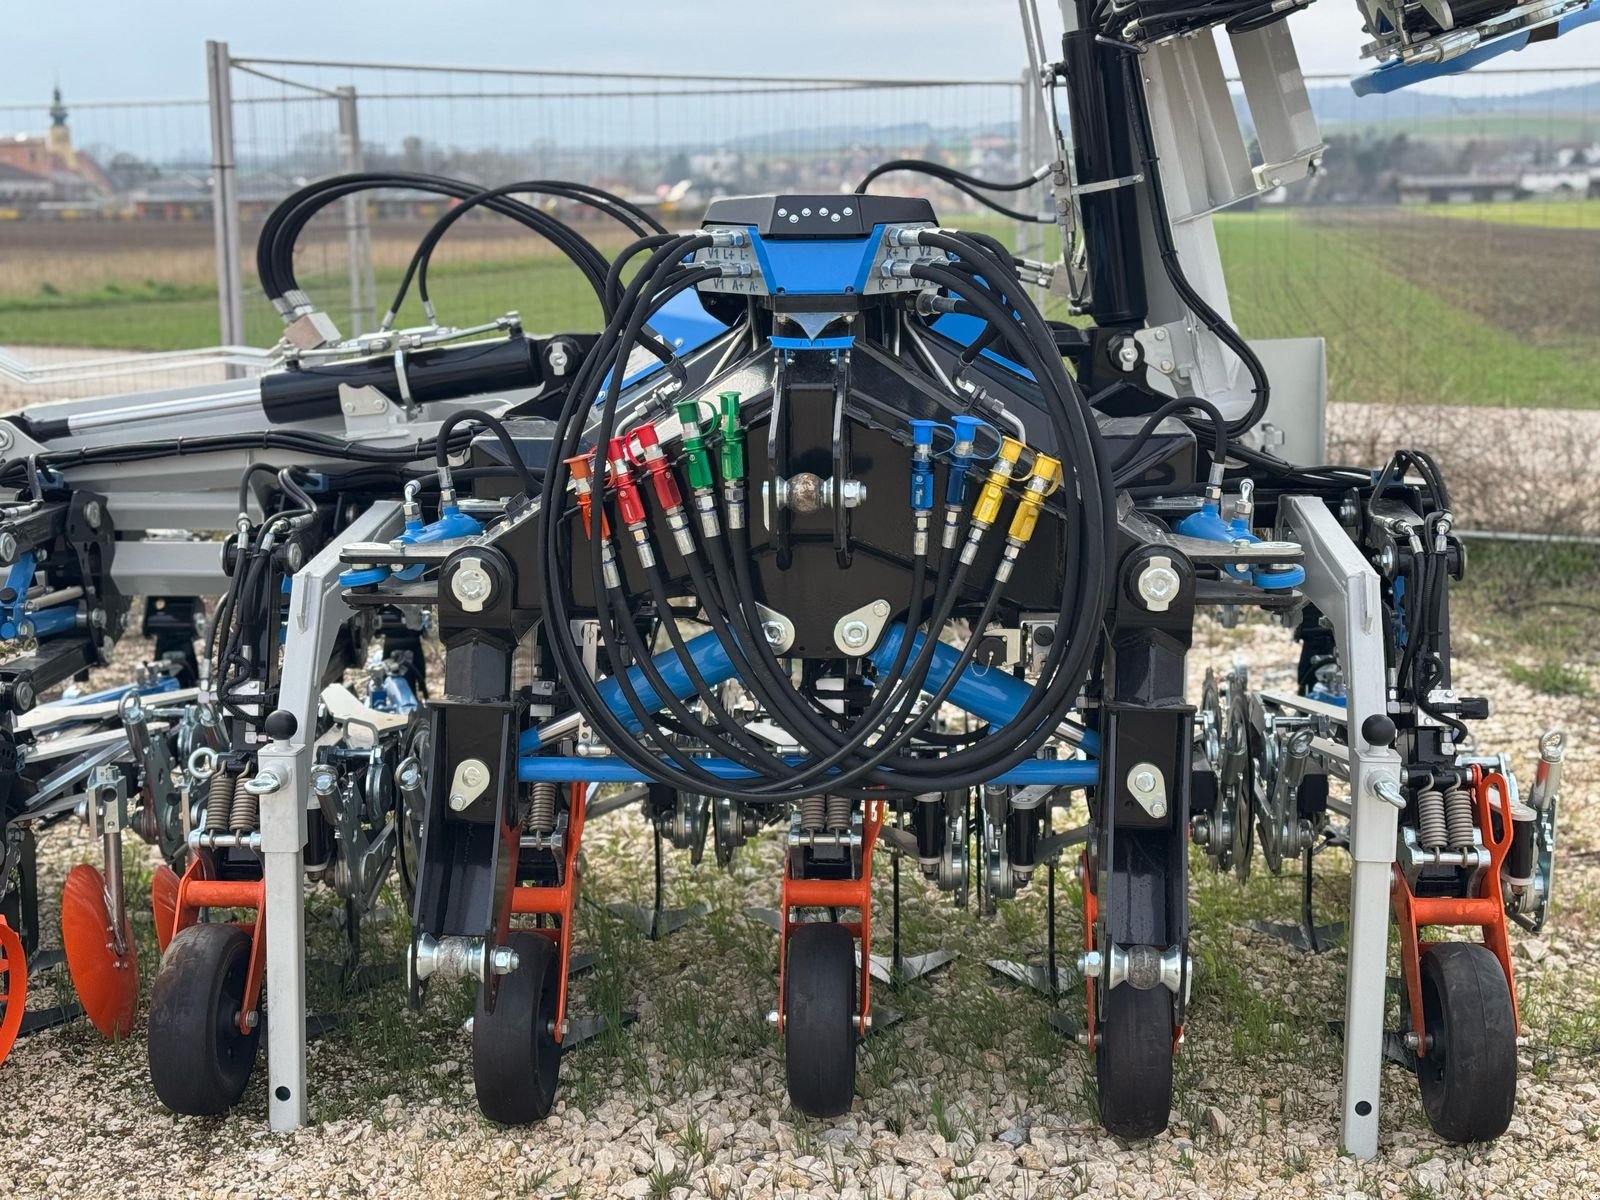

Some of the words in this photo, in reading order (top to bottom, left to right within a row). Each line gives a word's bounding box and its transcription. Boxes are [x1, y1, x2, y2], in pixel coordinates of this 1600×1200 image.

[708, 248, 718, 259] V1
[723, 248, 735, 260] L+
[886, 248, 899, 259] K+
[903, 247, 910, 257] T
[919, 246, 931, 256] V2
[713, 278, 724, 290] V1
[732, 279, 744, 291] A+
[749, 281, 759, 292] A-
[878, 279, 889, 291] K-
[896, 277, 903, 288] P
